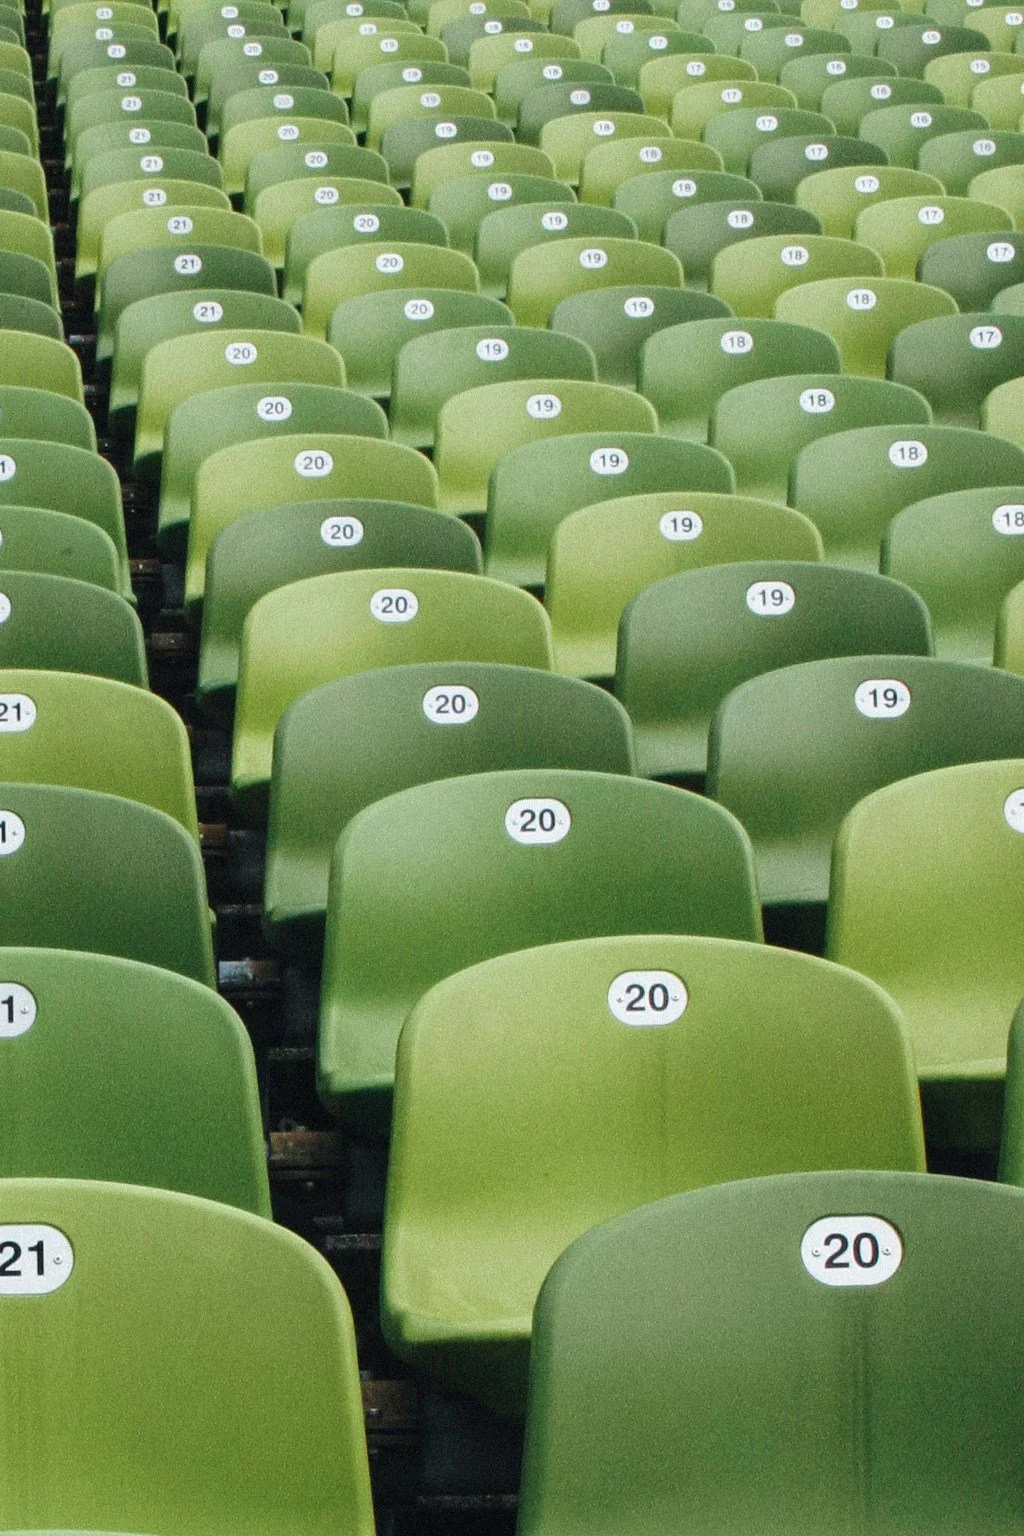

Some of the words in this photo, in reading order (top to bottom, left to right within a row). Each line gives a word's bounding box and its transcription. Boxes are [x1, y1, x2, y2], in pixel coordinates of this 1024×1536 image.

[599, 123, 611, 132] 18
[810, 147, 823, 157] 17
[145, 158, 158, 169] 21
[309, 155, 324, 164] 20
[678, 183, 692, 193] 18
[861, 179, 874, 188] 17
[148, 192, 161, 202] 21
[320, 190, 335, 200] 20
[494, 186, 508, 196] 19
[548, 215, 563, 226] 19
[734, 213, 749, 224] 18
[924, 210, 938, 220] 17
[173, 219, 187, 230] 21
[359, 217, 375, 228] 20
[788, 250, 803, 261] 18
[993, 246, 1009, 257] 17
[180, 258, 195, 270] 21
[382, 257, 399, 268] 20
[587, 252, 601, 264] 19
[853, 293, 870, 305] 18
[200, 305, 215, 318] 21
[411, 303, 429, 315] 20
[632, 301, 648, 313] 19
[728, 335, 746, 348] 18
[977, 331, 995, 343] 17
[233, 347, 251, 360] 20
[484, 343, 502, 356] 19
[535, 399, 554, 412] 19
[808, 394, 827, 407] 18
[264, 401, 285, 415] 20
[898, 446, 919, 461] 18
[303, 455, 325, 470] 20
[599, 453, 620, 468] 19
[670, 517, 693, 533] 19
[1002, 512, 1024, 527] 18
[330, 524, 354, 540] 20
[759, 588, 784, 607] 19
[381, 596, 408, 614] 20
[435, 694, 466, 714] 20
[868, 688, 898, 709] 19
[520, 808, 556, 833] 20
[625, 983, 670, 1012] 20
[823, 1231, 880, 1269] 20
